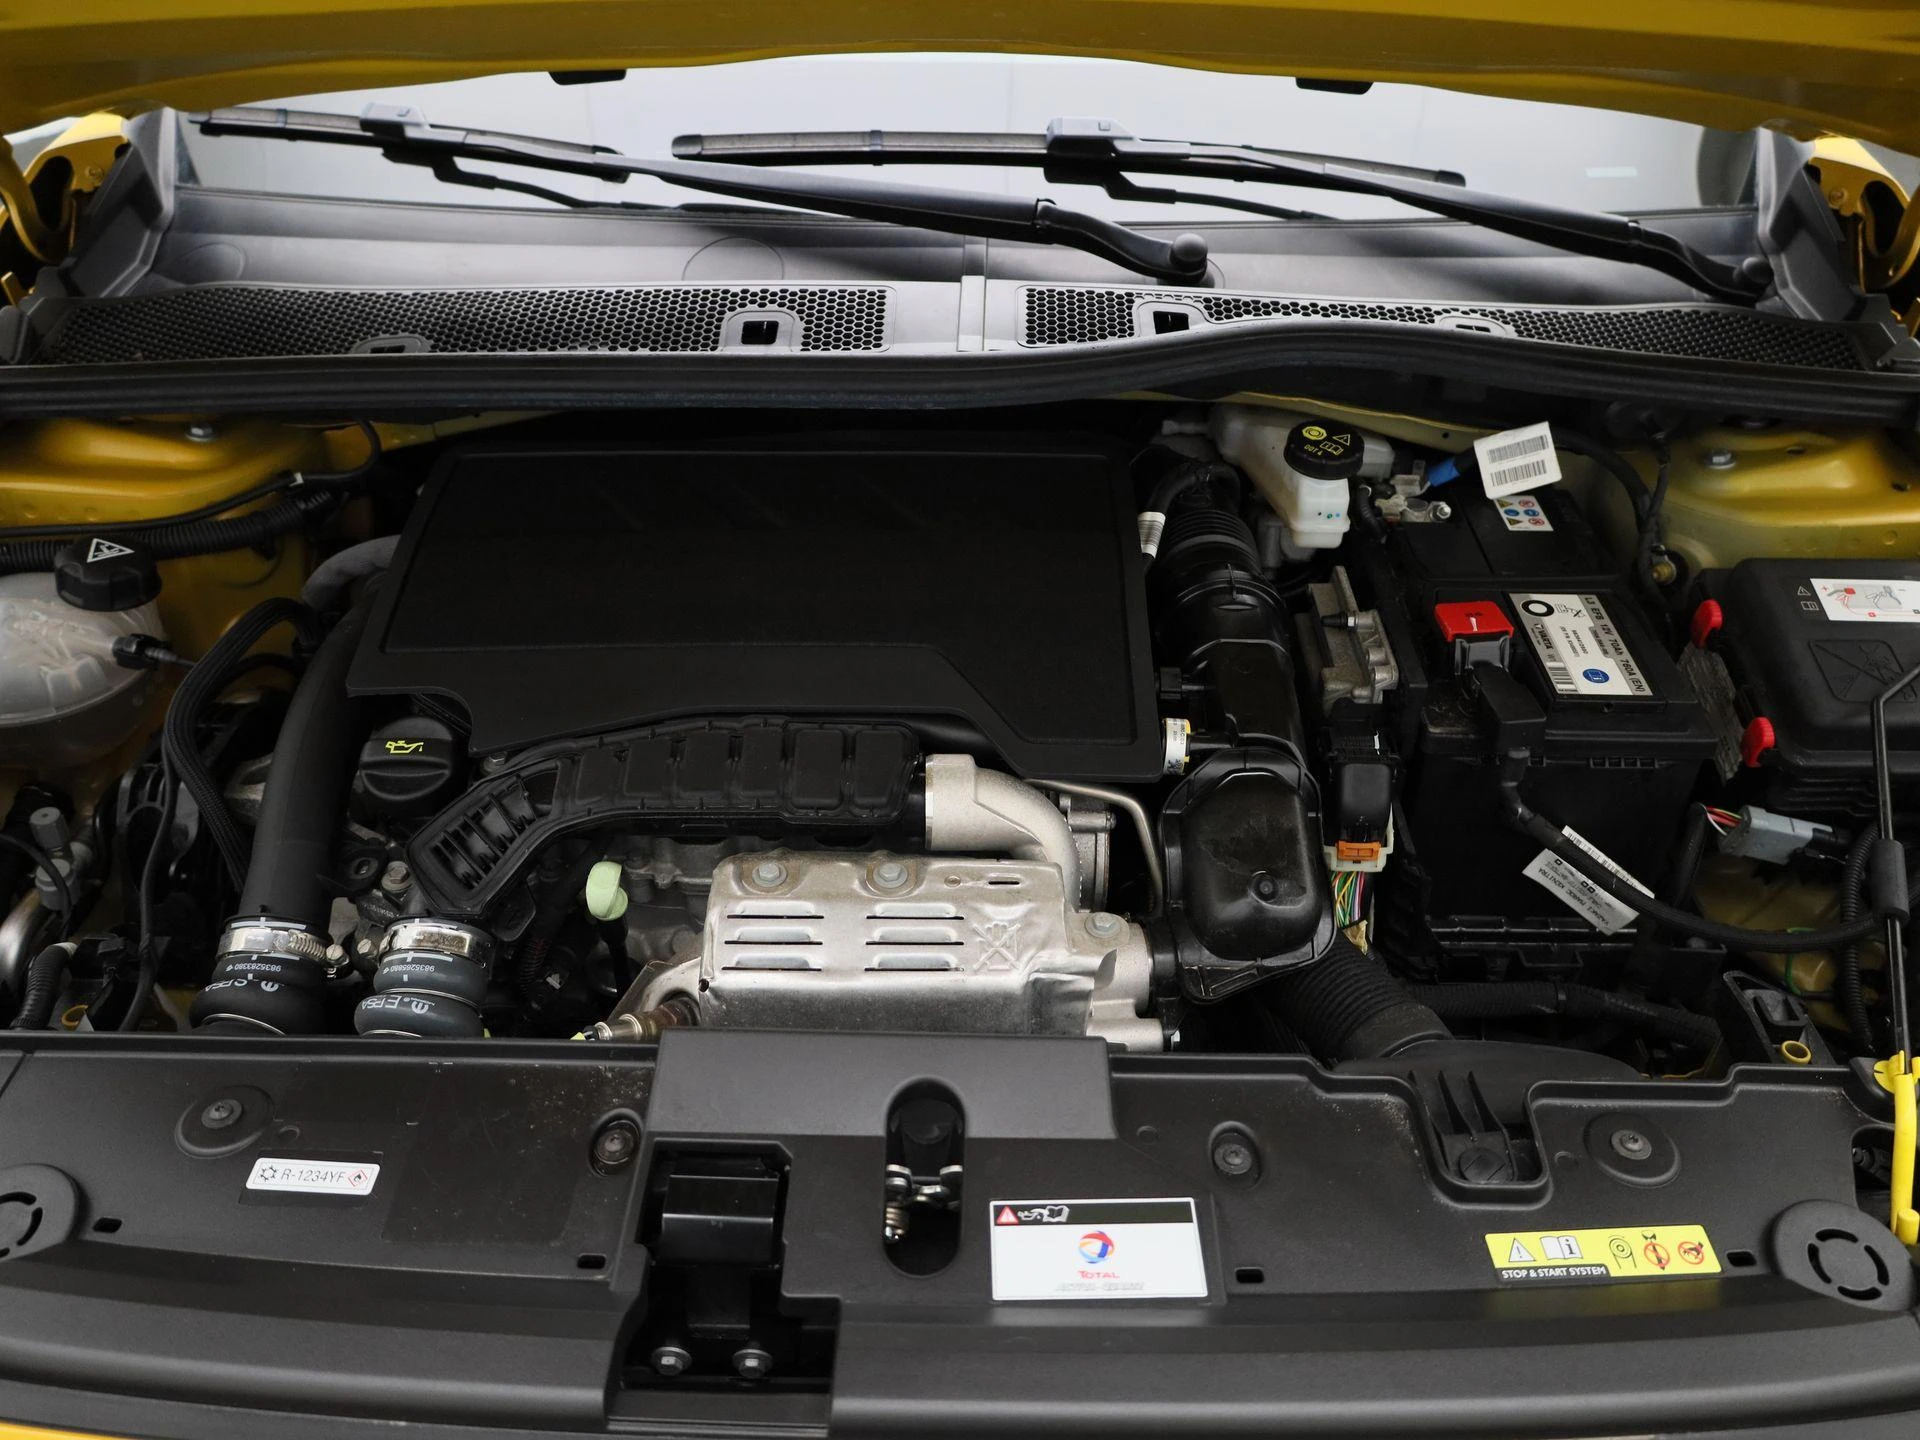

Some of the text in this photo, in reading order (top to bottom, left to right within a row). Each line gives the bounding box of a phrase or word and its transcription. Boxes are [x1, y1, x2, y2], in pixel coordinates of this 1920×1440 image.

[1538, 629, 1554, 650] VARTA
[1585, 597, 1596, 605] L3
[1591, 607, 1605, 621] EFB
[1600, 624, 1613, 636] 12V
[1608, 638, 1624, 656] 70Ah
[1620, 658, 1637, 677] 760A
[1629, 677, 1646, 693] (EN)
[280, 1168, 346, 1182] R-1234YF
[1078, 1270, 1120, 1279] TOTAL
[1502, 1266, 1607, 1279] STOP & START SYSTEM
